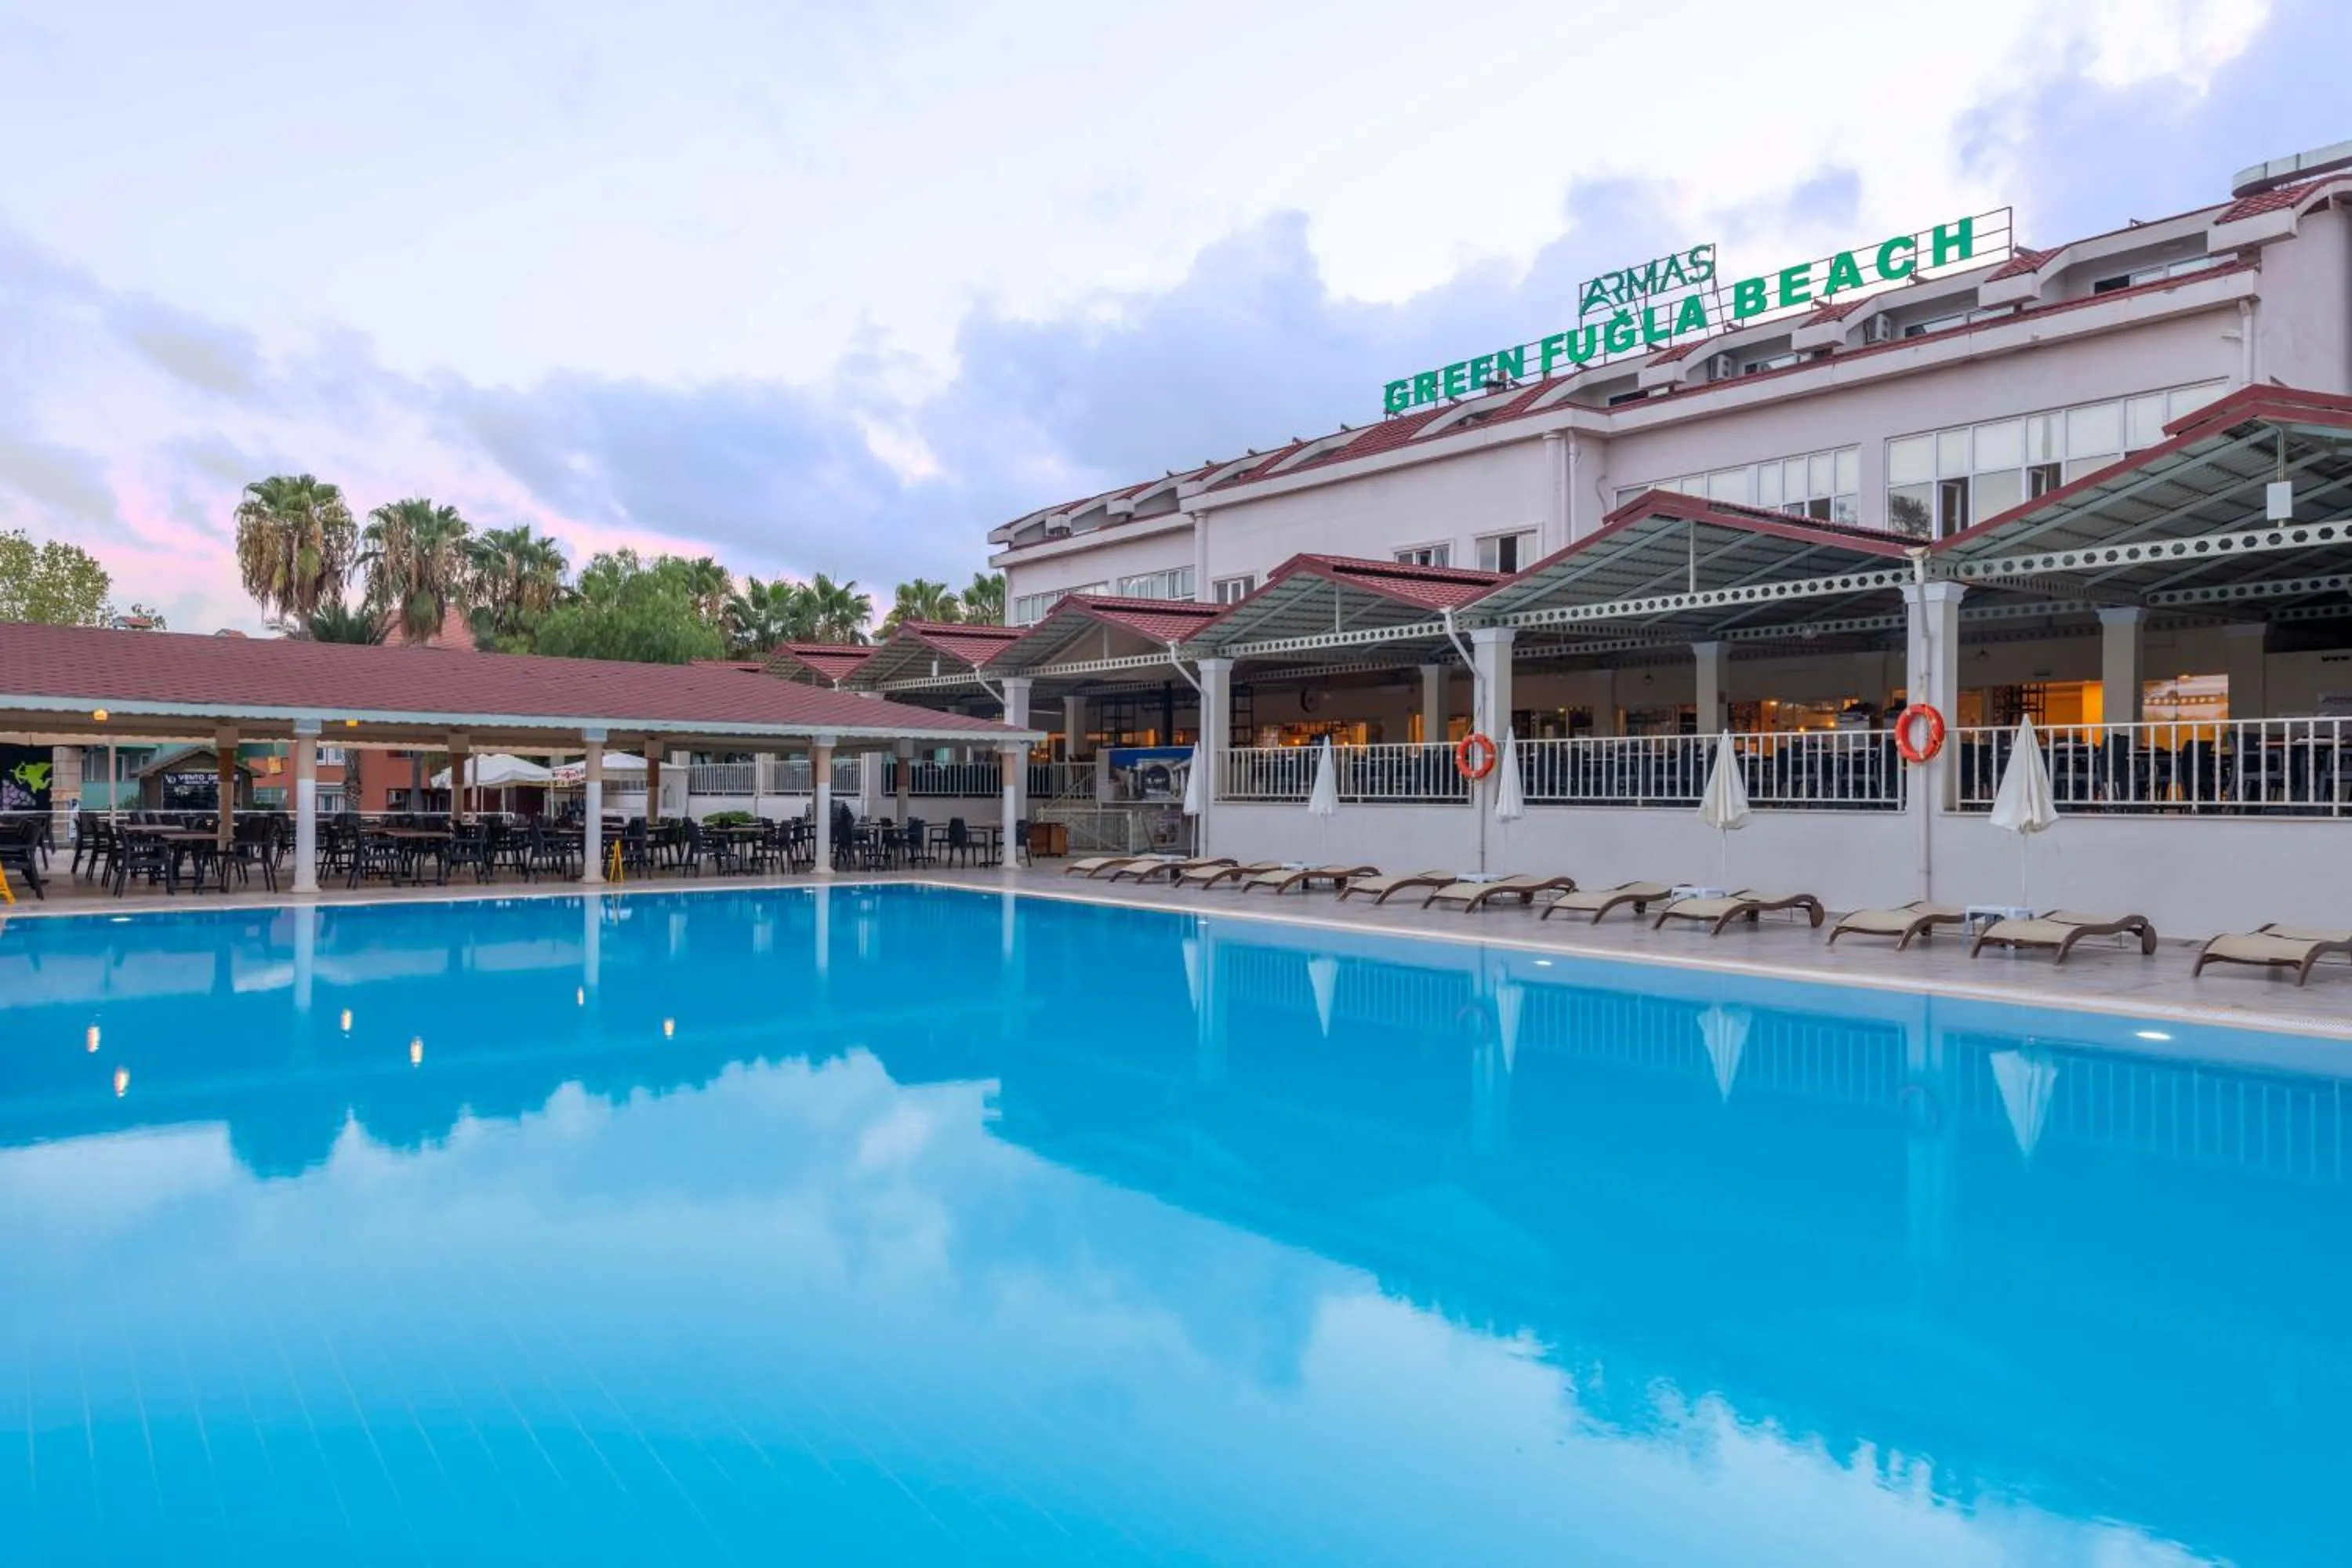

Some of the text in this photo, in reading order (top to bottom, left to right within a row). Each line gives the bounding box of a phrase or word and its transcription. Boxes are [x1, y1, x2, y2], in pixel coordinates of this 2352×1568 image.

[1385, 216, 1973, 412] GREEN FUĞLA BEACH
[1581, 245, 1714, 315] ARMAS
